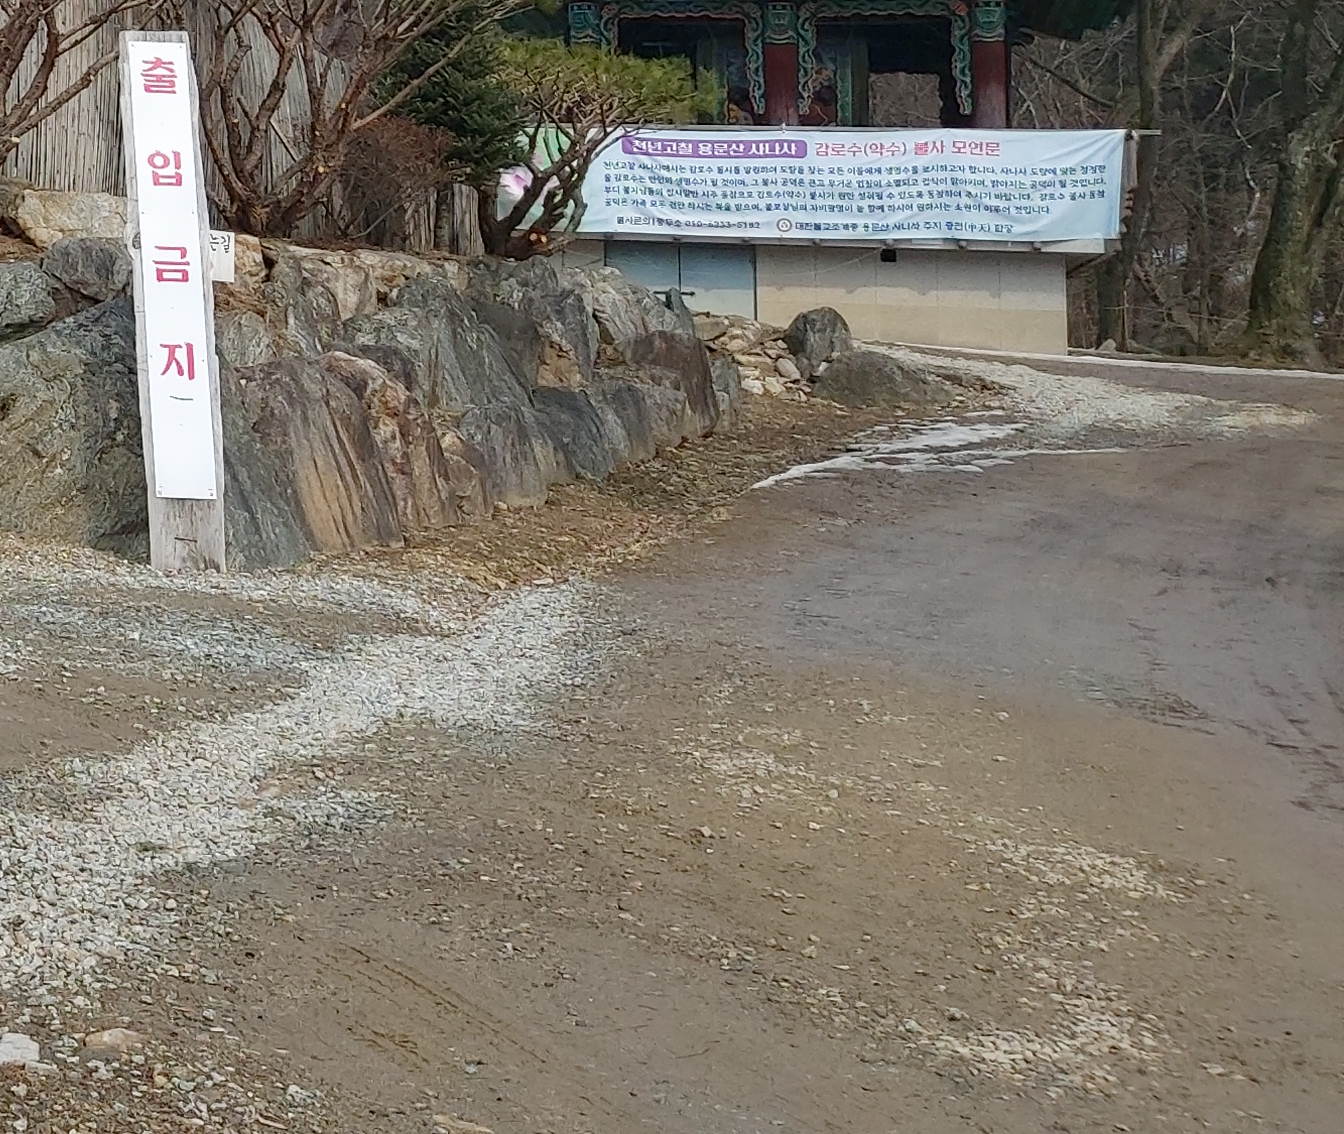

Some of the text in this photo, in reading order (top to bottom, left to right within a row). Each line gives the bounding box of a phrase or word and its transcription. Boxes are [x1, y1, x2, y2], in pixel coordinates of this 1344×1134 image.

[698, 142, 745, 156] 용문산
[748, 142, 798, 156] 사나사
[815, 141, 907, 157] 감로수(약수)
[951, 140, 1001, 157] 모연문
